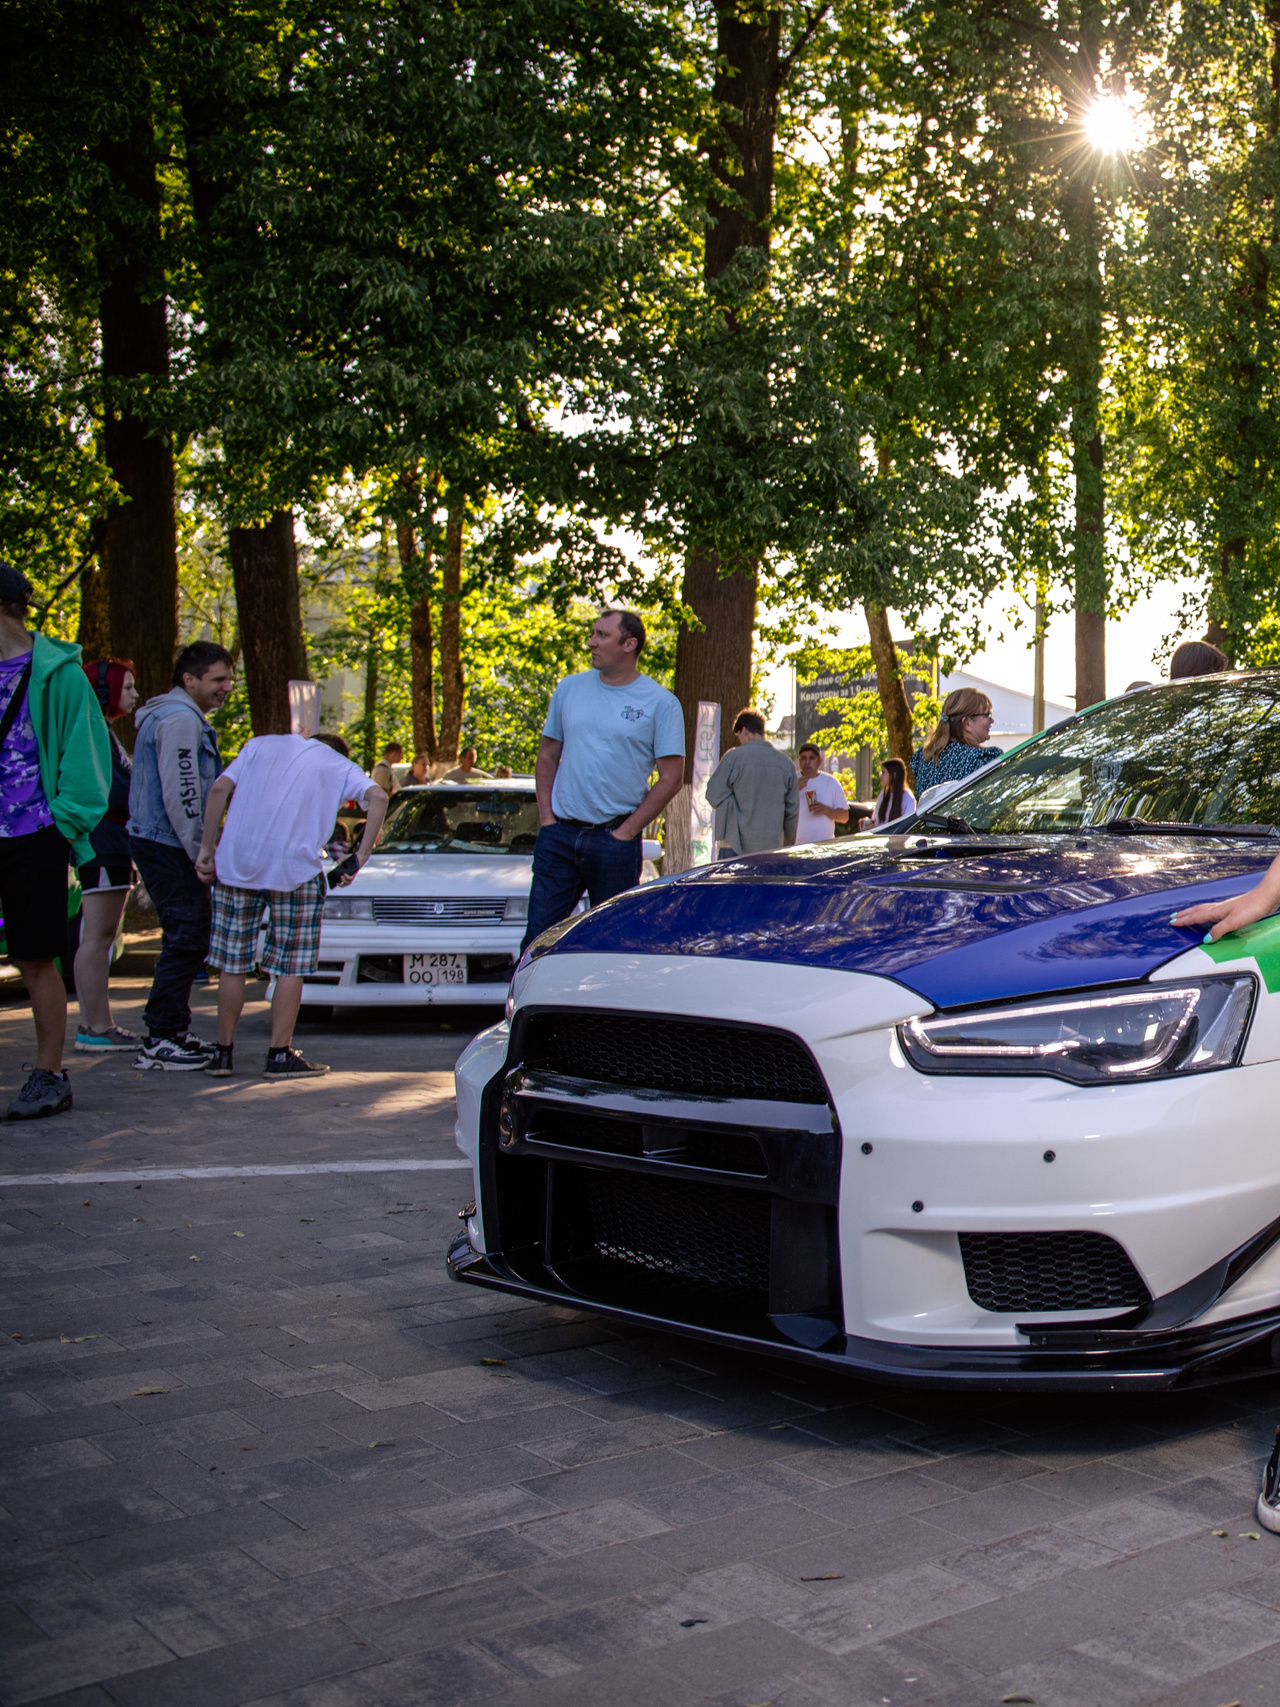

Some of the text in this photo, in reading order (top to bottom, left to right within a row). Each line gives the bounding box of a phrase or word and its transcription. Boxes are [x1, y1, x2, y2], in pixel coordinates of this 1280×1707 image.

[800, 689, 840, 702] Квартиры
[840, 688, 849, 697] за
[178, 748, 200, 819] FASHION
[430, 953, 457, 967] 287
[442, 969, 464, 981] 198
